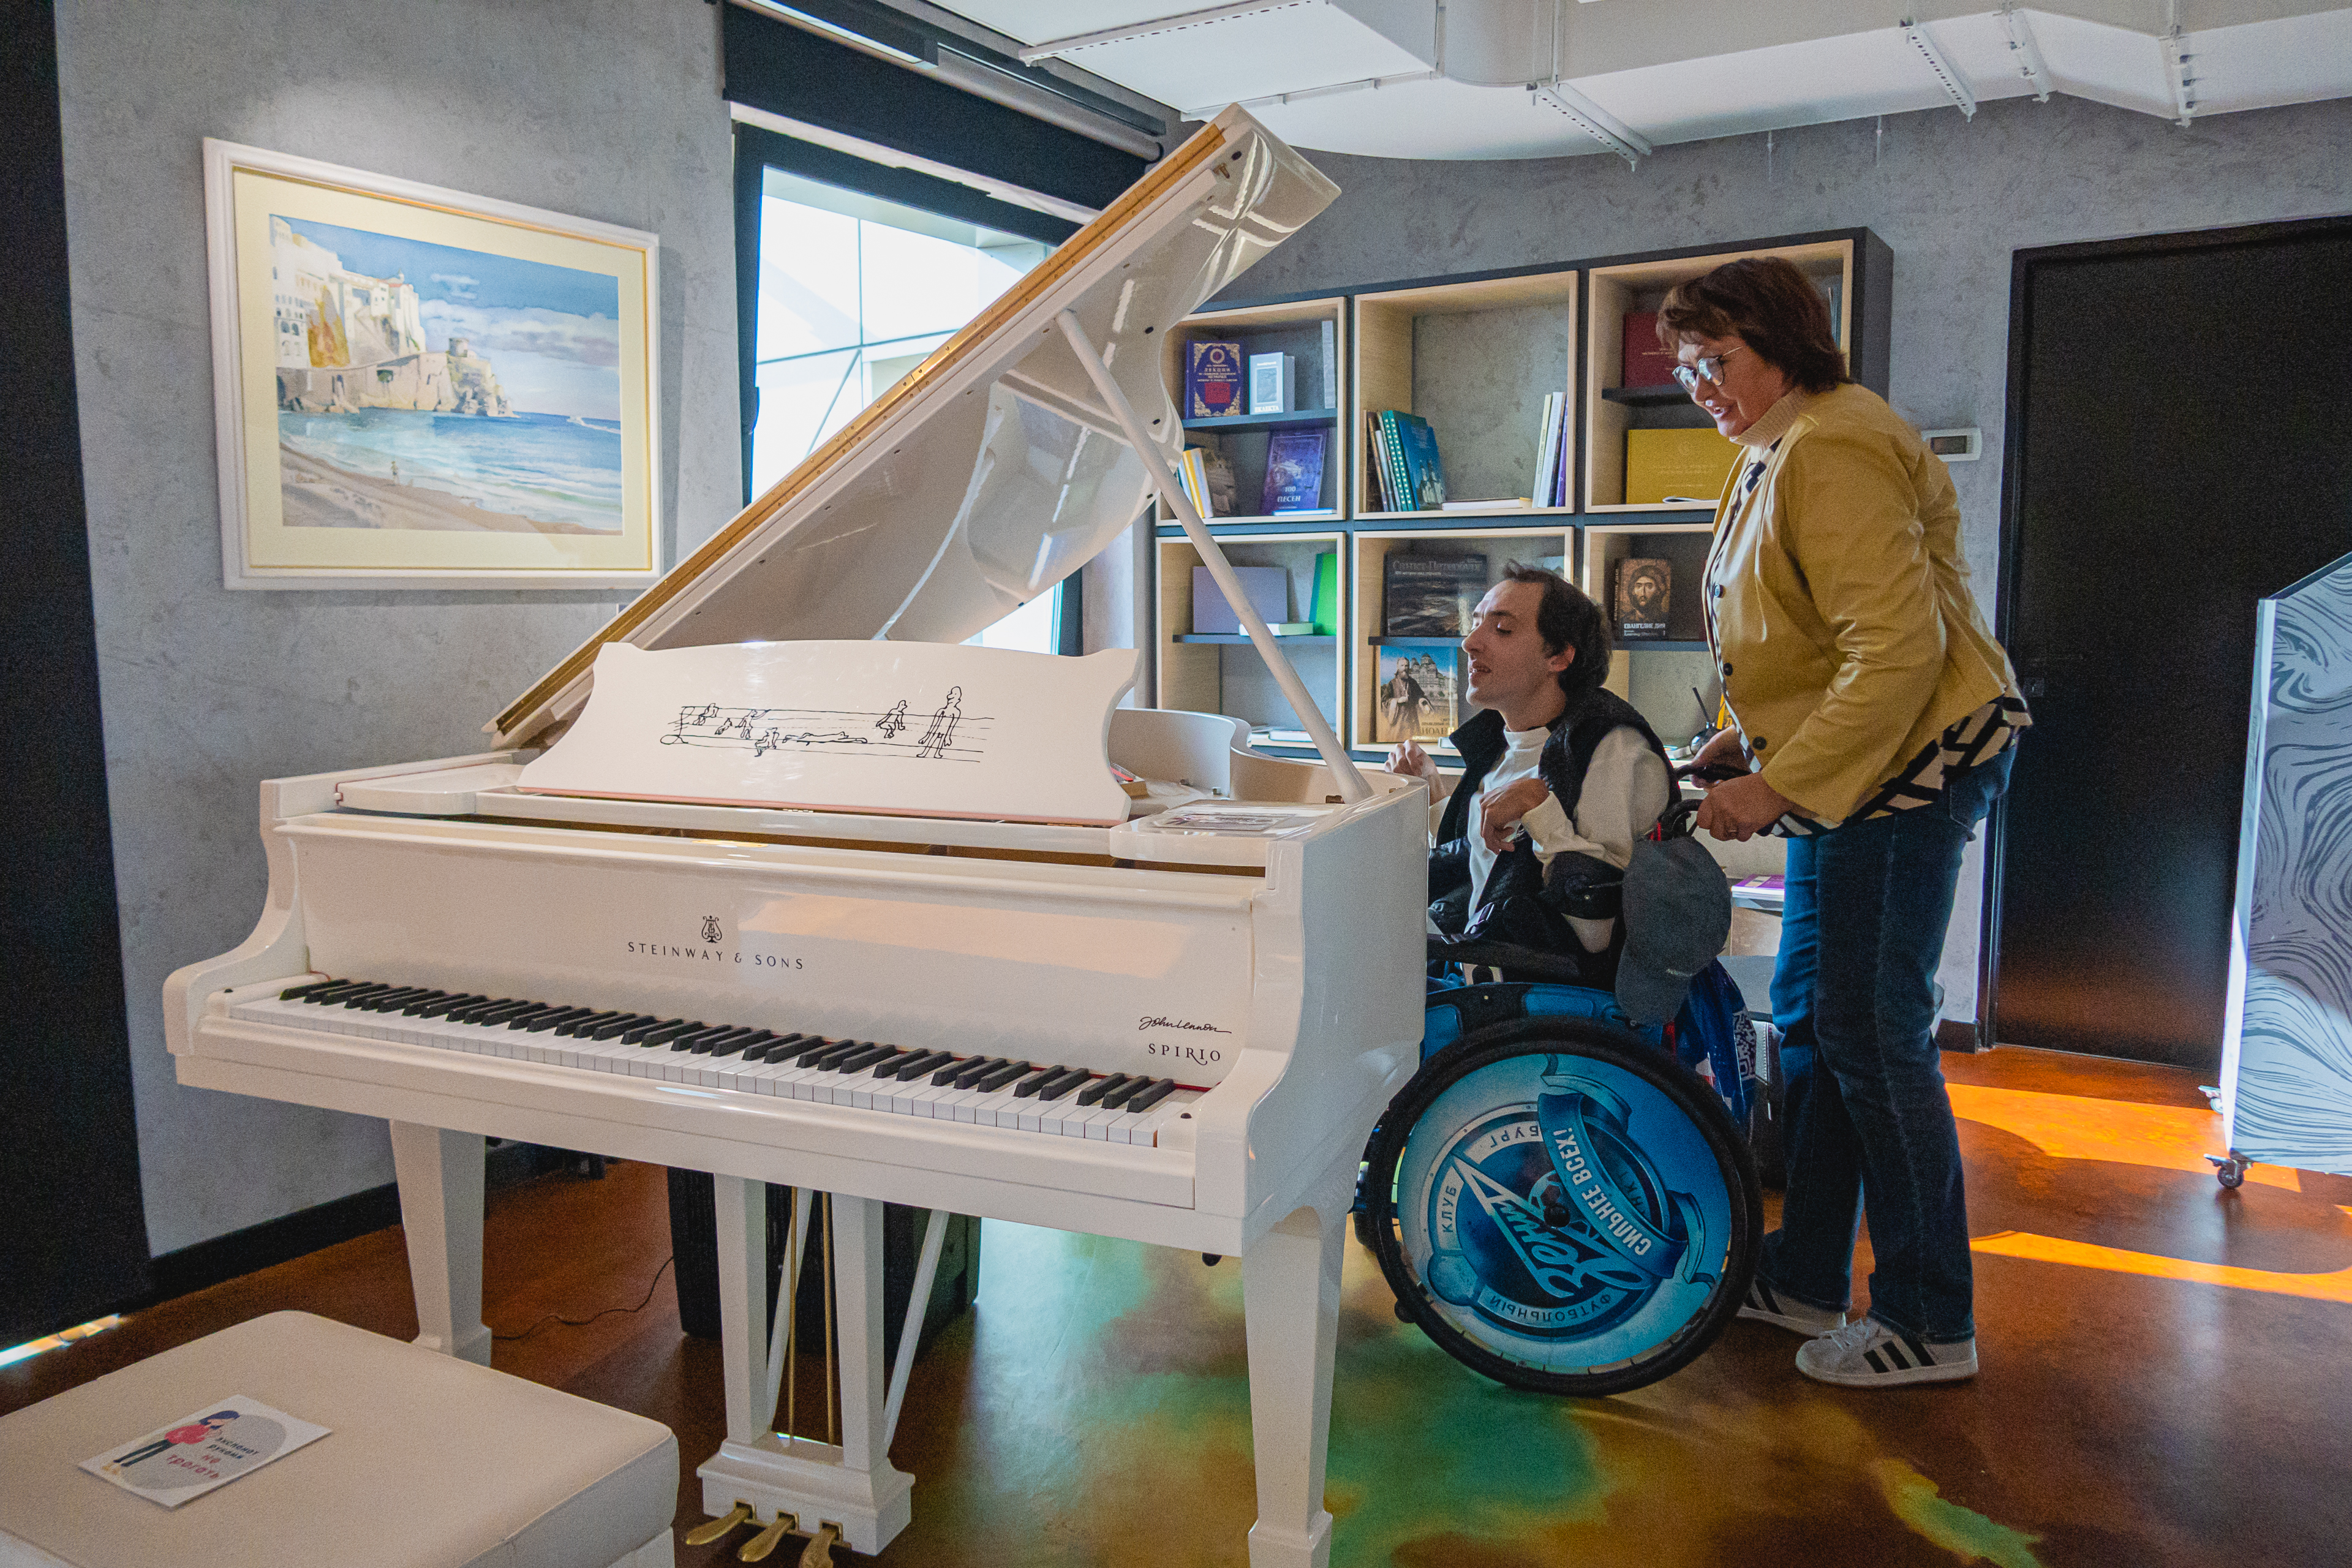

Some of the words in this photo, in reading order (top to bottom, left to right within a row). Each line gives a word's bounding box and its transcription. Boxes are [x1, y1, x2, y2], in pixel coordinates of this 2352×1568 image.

[628, 941, 723, 962] STEINWAY
[734, 952, 742, 963] &
[755, 954, 803, 970] SONS
[1148, 1043, 1221, 1066] SPIRIO
[1551, 1128, 1593, 1186] ВСЕХ!
[1442, 1185, 1458, 1233] КЛУБ
[1581, 1184, 1653, 1256] СИЛЬНЕЕ
[1489, 1292, 1612, 1323] ФУТБОЛЬНЫЙ
